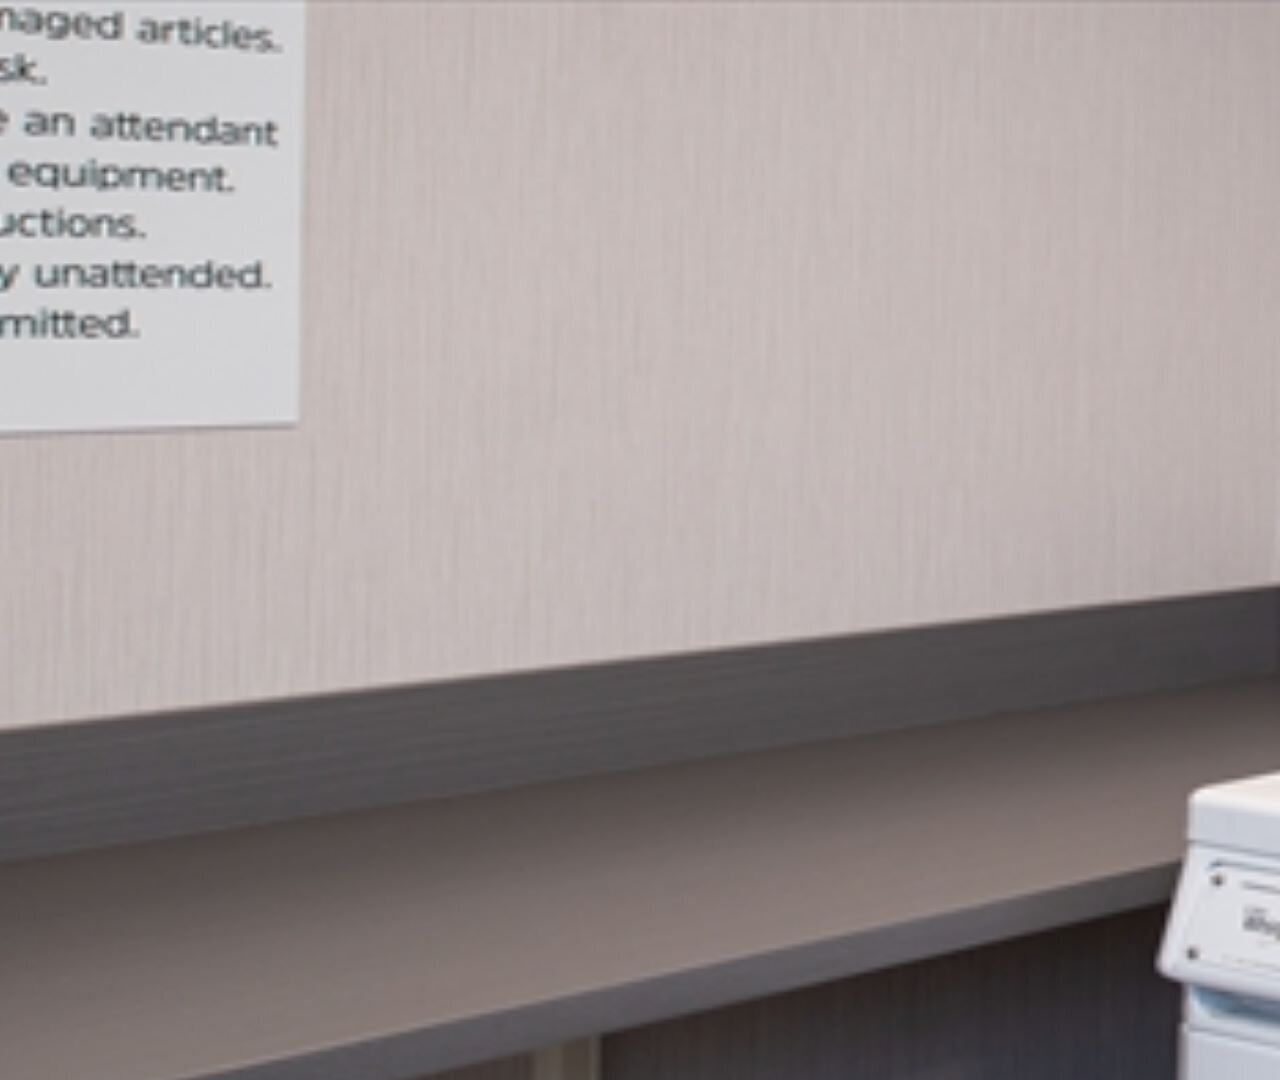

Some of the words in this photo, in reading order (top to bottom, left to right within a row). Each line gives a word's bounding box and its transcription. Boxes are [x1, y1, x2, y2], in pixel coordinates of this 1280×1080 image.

[136, 16, 283, 52] articles.
[24, 110, 75, 137] an
[90, 113, 278, 147] attendant
[8, 159, 235, 193] equipment.
[35, 261, 273, 289] unattended.
[0, 307, 140, 339] mitted.
